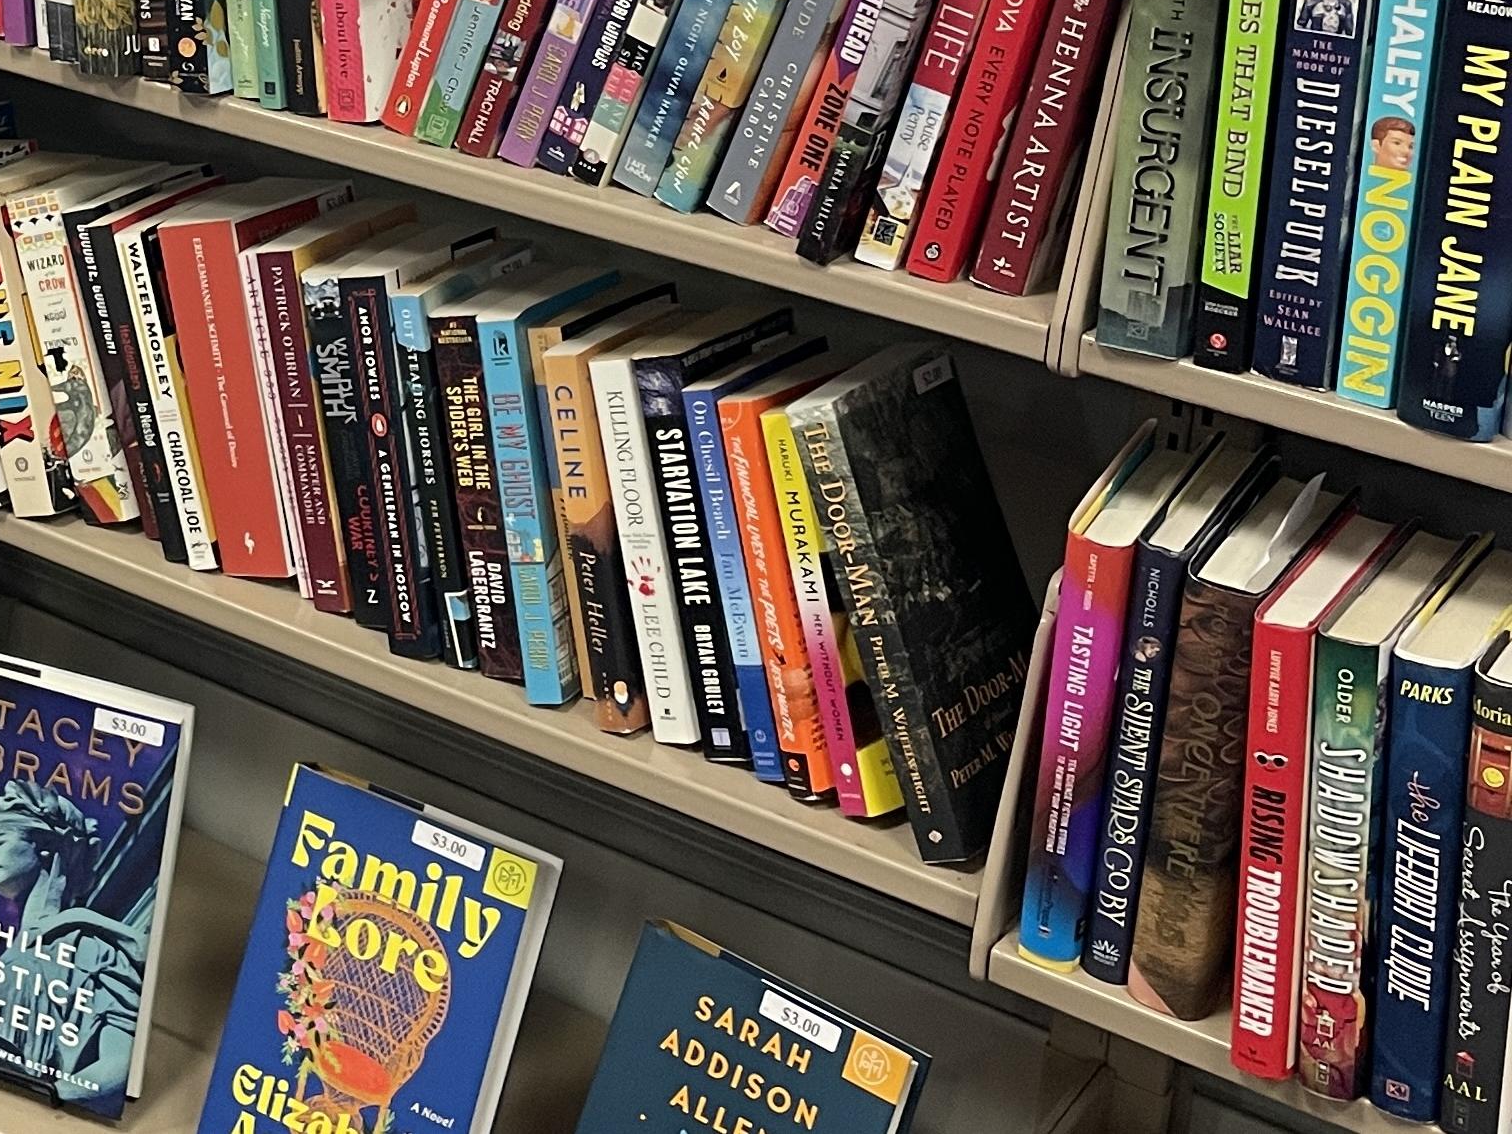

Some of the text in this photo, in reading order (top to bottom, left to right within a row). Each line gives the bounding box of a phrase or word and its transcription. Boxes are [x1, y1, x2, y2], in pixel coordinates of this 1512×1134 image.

[923, 1, 975, 78] LIFE
[1229, 46, 1257, 120] THAT
[1000, 14, 1088, 250] HENNA ARTIST
[1121, 26, 1193, 299] INSURGENT
[1222, 132, 1249, 198] BIND
[1276, 77, 1340, 287] DIESELPUNK
[1431, 44, 1510, 336] MY PLAIN JANE
[128, 241, 174, 401] WALTER MOSLEY
[1342, 165, 1413, 397] NOGGIN
[554, 385, 587, 500] CELINE
[606, 390, 646, 528] KILLING FLOOR
[655, 427, 712, 607] STARVATION LAKE
[785, 490, 819, 605] MURAKAMI
[803, 421, 879, 628] THE DOOR-MAN
[468, 550, 496, 649] LAGERCRANTZ
[486, 562, 506, 605] DAVID
[1143, 567, 1161, 628] NICHOLLS
[642, 602, 672, 700] LEE CHILD
[1058, 626, 1094, 752] TASTING LIGHT
[1334, 668, 1354, 723] OLDER
[1400, 680, 1454, 705] PARKS
[111, 717, 147, 737] $3.00
[291, 811, 502, 959] Family
[430, 833, 468, 858] $3.00
[1307, 741, 1367, 995] SHADOWSHAPER
[307, 889, 449, 994] Lore
[1238, 784, 1287, 1038] RISING TROUBLEMAKER
[694, 995, 813, 1075] SARAH
[780, 1007, 821, 1037] $3.00
[25, 1059, 100, 1091] BESTSELLER
[422, 1106, 455, 1129] Novel
[660, 1028, 819, 1131] ADDISON
